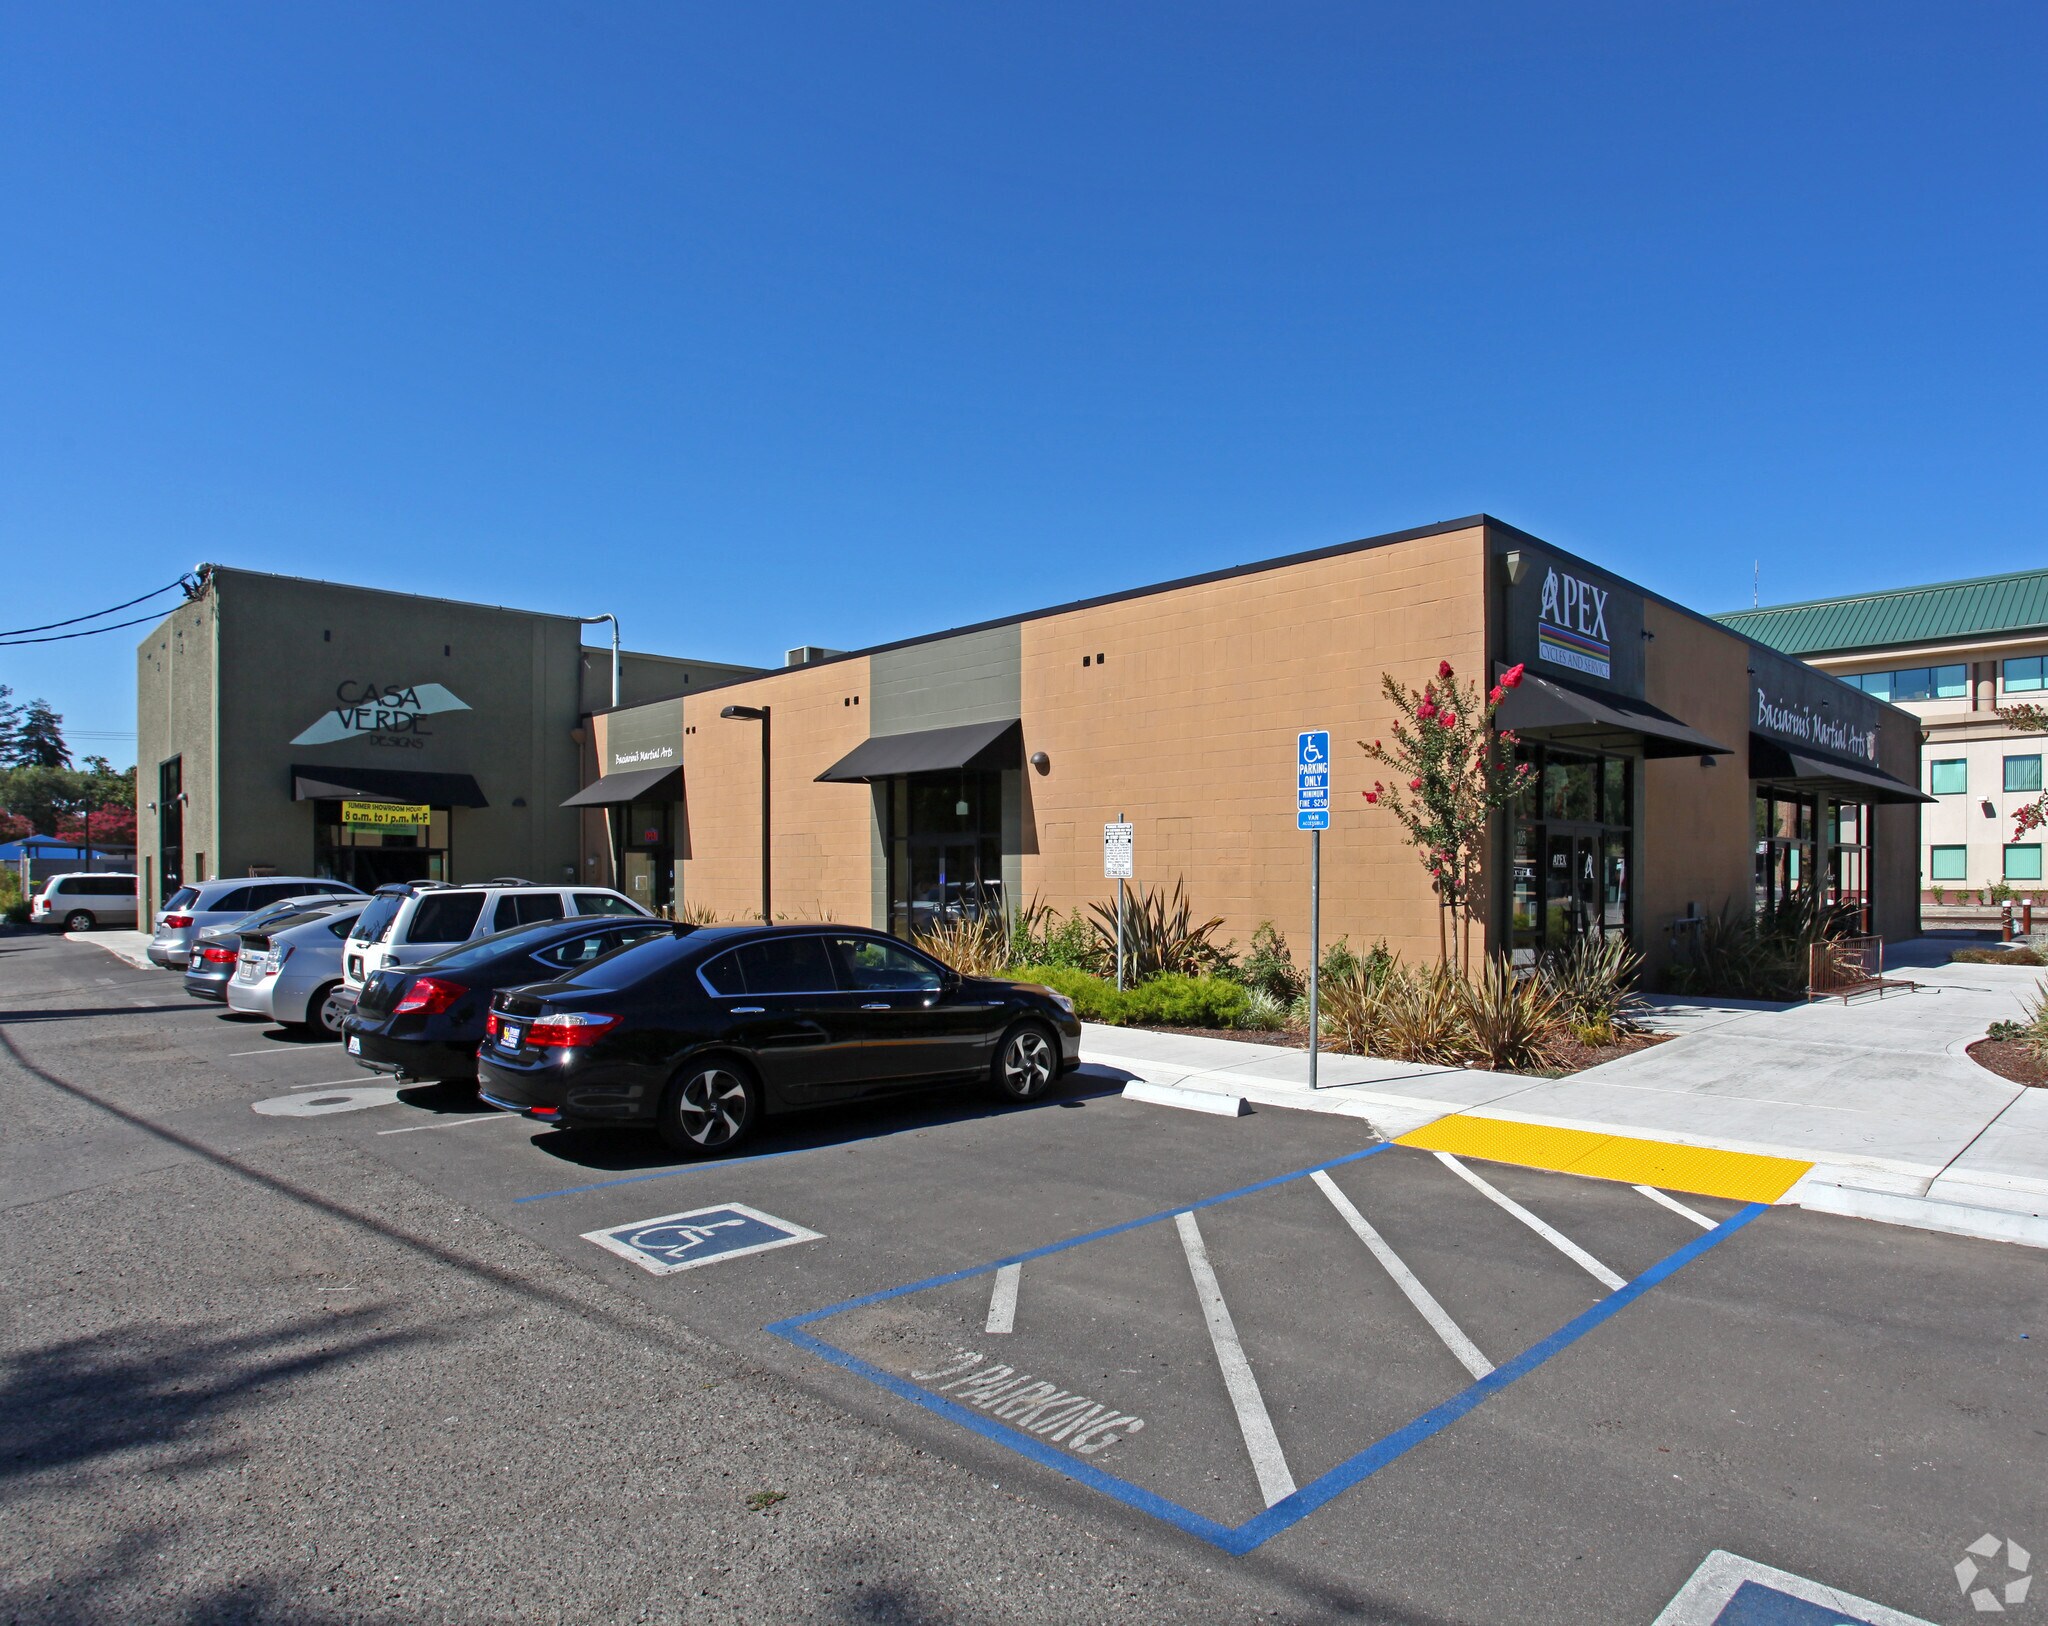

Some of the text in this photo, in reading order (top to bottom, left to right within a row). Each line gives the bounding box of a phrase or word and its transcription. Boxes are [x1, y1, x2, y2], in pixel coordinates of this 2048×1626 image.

[1539, 566, 1610, 642] APEX
[1540, 644, 1609, 678] CYCLES AND SERVICE
[336, 680, 421, 709] CASA
[336, 707, 432, 735] VERDE
[1757, 687, 1866, 757] Baciarini's Martial Arts
[370, 735, 424, 749] DESIGNS
[639, 748, 660, 761] Martial
[660, 747, 673, 758] Arts
[1299, 762, 1328, 775] PARKING
[1304, 775, 1322, 787] ONLY
[348, 802, 371, 810] SUMMER
[372, 803, 405, 812] SHOWROOM
[345, 811, 351, 820] 8
[352, 813, 372, 821] a.m.
[374, 812, 383, 822] to
[390, 815, 409, 824] p.m.
[411, 813, 428, 823] M-F
[1552, 854, 1567, 865] APEX
[938, 1364, 1145, 1454] PARKING
